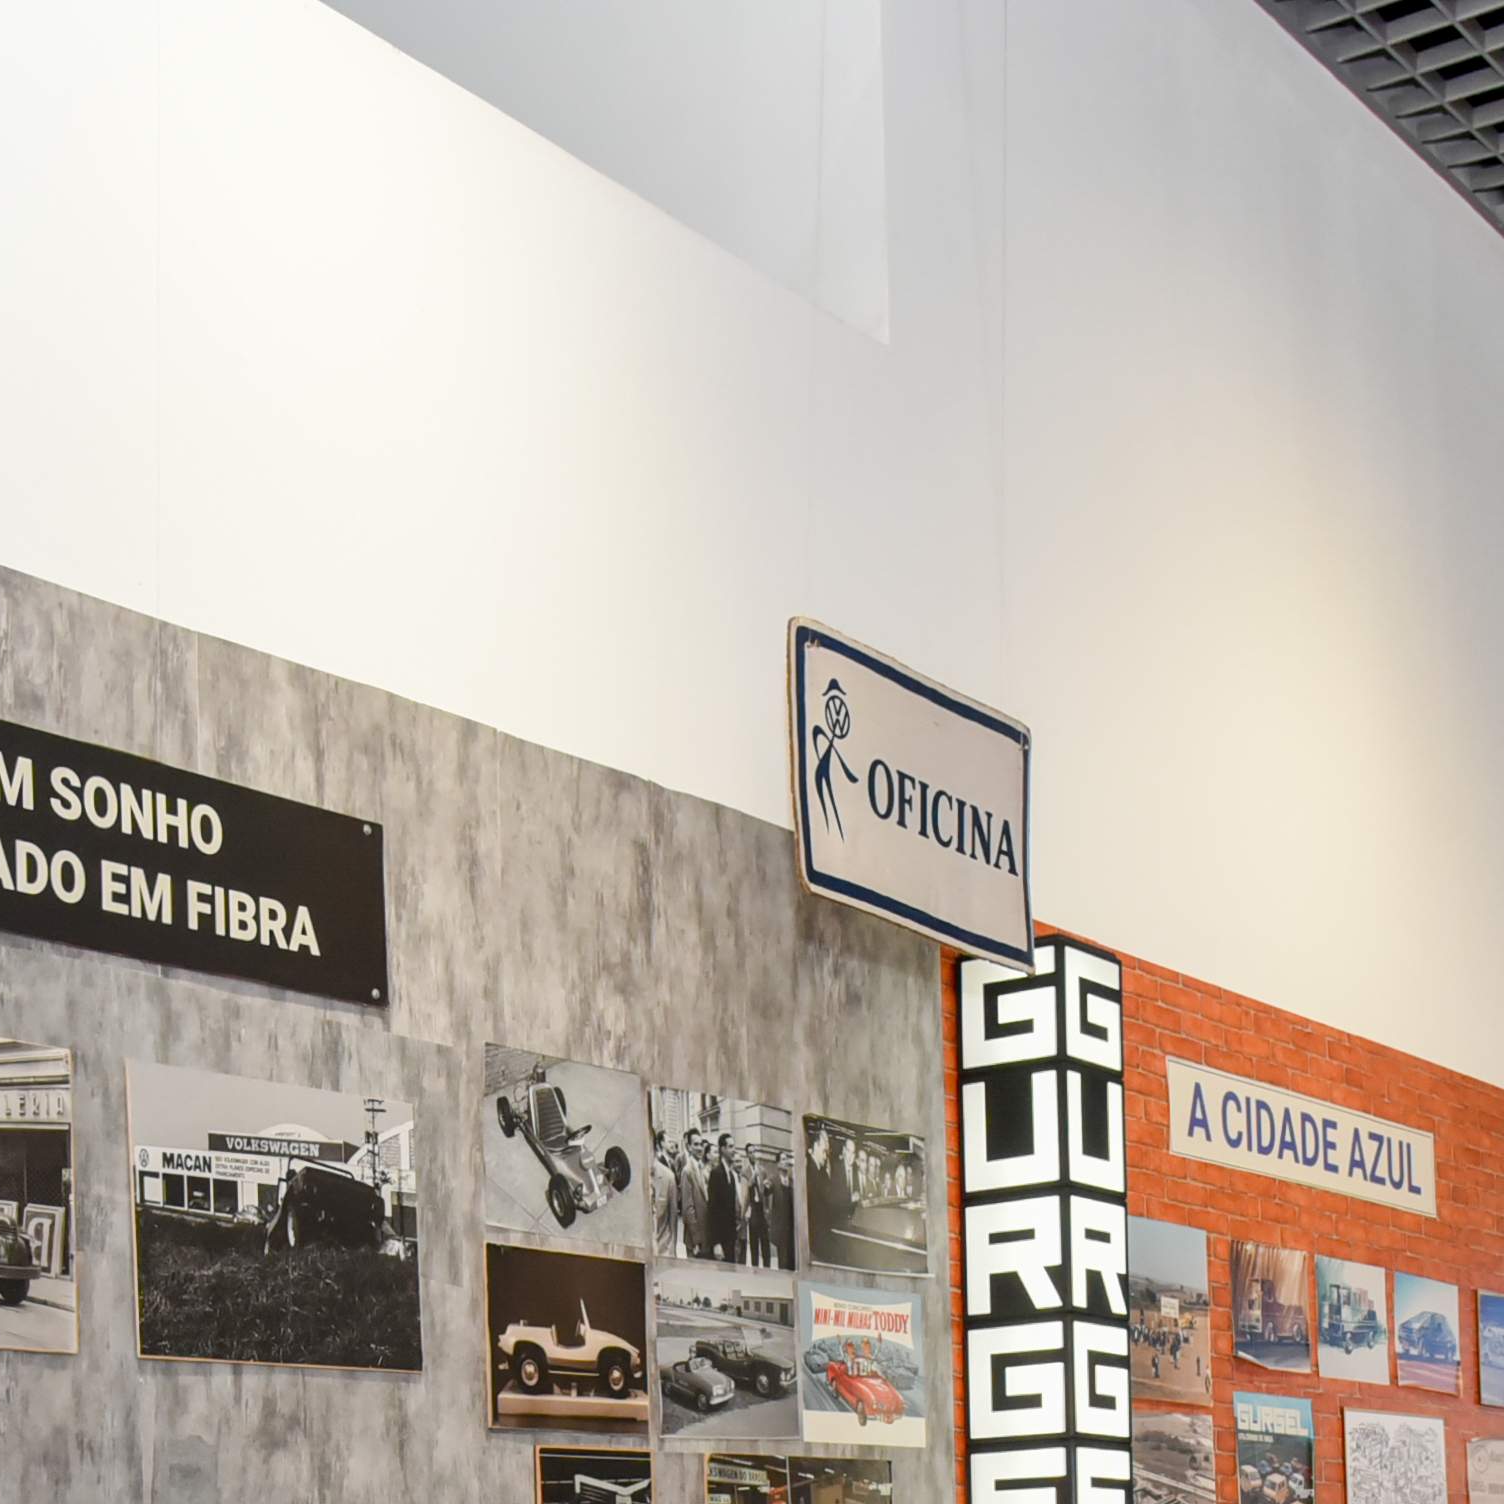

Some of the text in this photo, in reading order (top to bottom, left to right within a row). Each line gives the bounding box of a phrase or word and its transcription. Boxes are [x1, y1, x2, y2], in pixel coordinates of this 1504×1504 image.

[49, 765, 224, 856] SONHO
[868, 759, 1019, 877] OFICINA
[100, 858, 173, 925] EM
[186, 880, 321, 957] FIBRA
[162, 1151, 212, 1173] MACAN
[225, 1137, 320, 1157] VOLKSWAGEN
[1187, 1081, 1422, 1196] A CIDADE AZUL
[872, 1311, 909, 1334] TODDY
